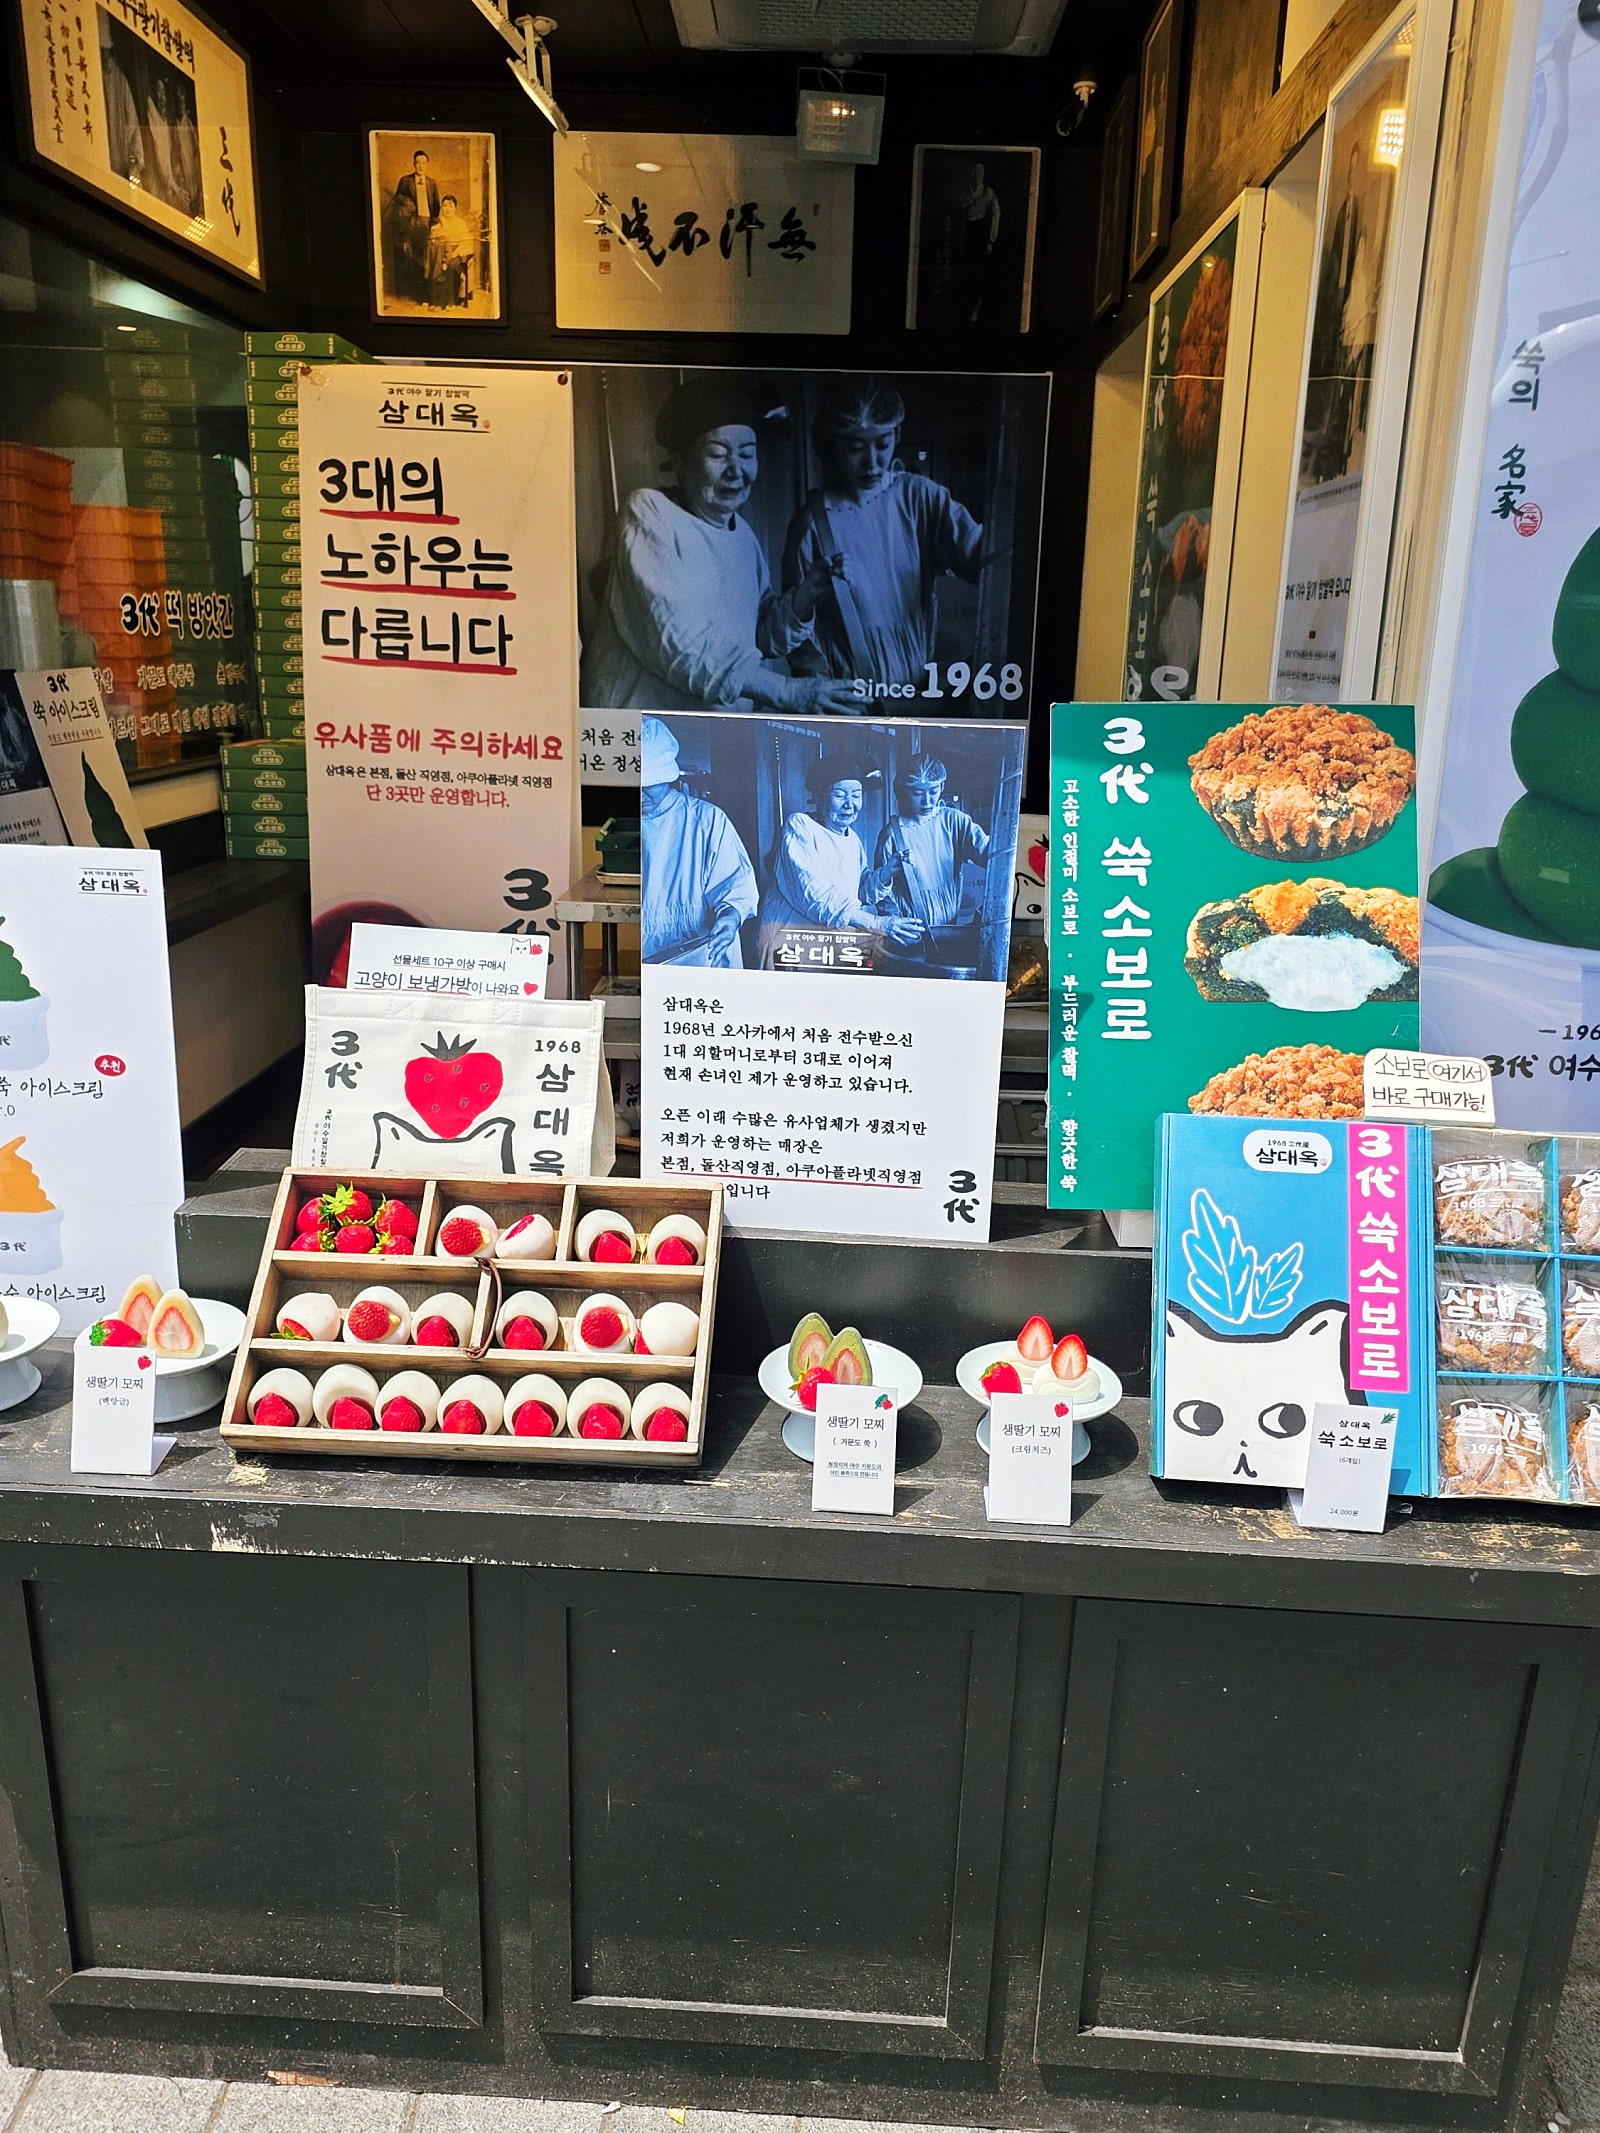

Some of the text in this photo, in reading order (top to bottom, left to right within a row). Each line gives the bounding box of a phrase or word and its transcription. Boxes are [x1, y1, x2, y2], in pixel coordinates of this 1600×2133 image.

[1508, 339, 1545, 412] 쑥의
[425, 388, 442, 398] 딸기
[445, 389, 471, 399] 찹쌀떡
[378, 399, 479, 429] 삼대옥
[318, 456, 444, 517] 3대의
[1490, 443, 1526, 520] 名家
[320, 532, 513, 591] 노하우는
[119, 589, 235, 640] 3代 떡 방앗간
[321, 605, 514, 667] 다릅니다
[46, 673, 70, 693] 3代
[852, 661, 1024, 701] Since 1968
[33, 696, 100, 726] 쑥 아이스크림
[314, 721, 564, 761] 유사품에 주의하세요
[581, 727, 641, 747] 처음 전
[1099, 717, 1154, 805] 3代
[325, 764, 553, 789] 삼대옥은 본점, 돌산 직영점, 아쿠아플라넷 직영점
[366, 784, 511, 808] 단 3곳만 운영합니다.
[78, 877, 141, 894] 삼대옥
[785, 933, 801, 941] 3代
[817, 934, 833, 943] 딸기
[835, 935, 857, 944] 찹쌀떡
[1100, 836, 1153, 1041] 쑥소보로
[392, 953, 506, 972] 선물세트 10구 이상 구매시
[776, 943, 864, 967] 삼대옥
[354, 971, 520, 996] 고양이 보냉가방이 나와요
[1059, 779, 1080, 1194] 고소한 인절미 소보로 부드러운 찰떡 향긋한 쑥
[662, 996, 724, 1014] 삼대옥은
[533, 1039, 582, 1054] 1968
[663, 1021, 913, 1048] 1968년 오사카에서 처음 전수받으신
[99, 1058, 122, 1074] 추천
[324, 1029, 363, 1090] 3代
[663, 1043, 892, 1071] 1대 외할머니로부터 3대로 이어져
[1374, 1052, 1484, 1082] 소보로 여기서
[1482, 1053, 1600, 1082] 3代 여수
[20, 1077, 105, 1100] 아이스크림
[663, 1065, 913, 1094] 현재 손녀인 제가 운영하고 있습니다.
[1372, 1085, 1411, 1106] 바로
[528, 1062, 576, 1176] 삼대옥
[660, 1107, 928, 1136] 오픈 이래 수많은 유사업체가 생겼지만
[660, 1131, 823, 1155] 저희가 운영하는 매장은
[1267, 1139, 1287, 1147] 1968
[1255, 1147, 1319, 1168] 삼대옥
[1355, 1128, 1401, 1199] 3代
[660, 1155, 922, 1185] 본점, 돌산직영점, 아쿠아플라넷직영점
[726, 1182, 771, 1200] 입니다
[942, 1169, 981, 1224] 3代
[26, 1283, 107, 1304] 아이스크림
[1357, 1210, 1401, 1379] 쑥소보로
[1458, 1328, 1494, 1343] 1968
[85, 1375, 144, 1391] 생딸기 모찌
[826, 1415, 885, 1431] 생딸기 모찌
[1002, 1423, 1061, 1439] 생딸기 모찌
[1338, 1419, 1371, 1430] 삼대옥
[840, 1437, 862, 1447] 거문도
[1011, 1445, 1052, 1456] (크림치즈)
[1317, 1430, 1388, 1451] 쑥소보로
[1329, 1507, 1359, 1517] 24,000원
